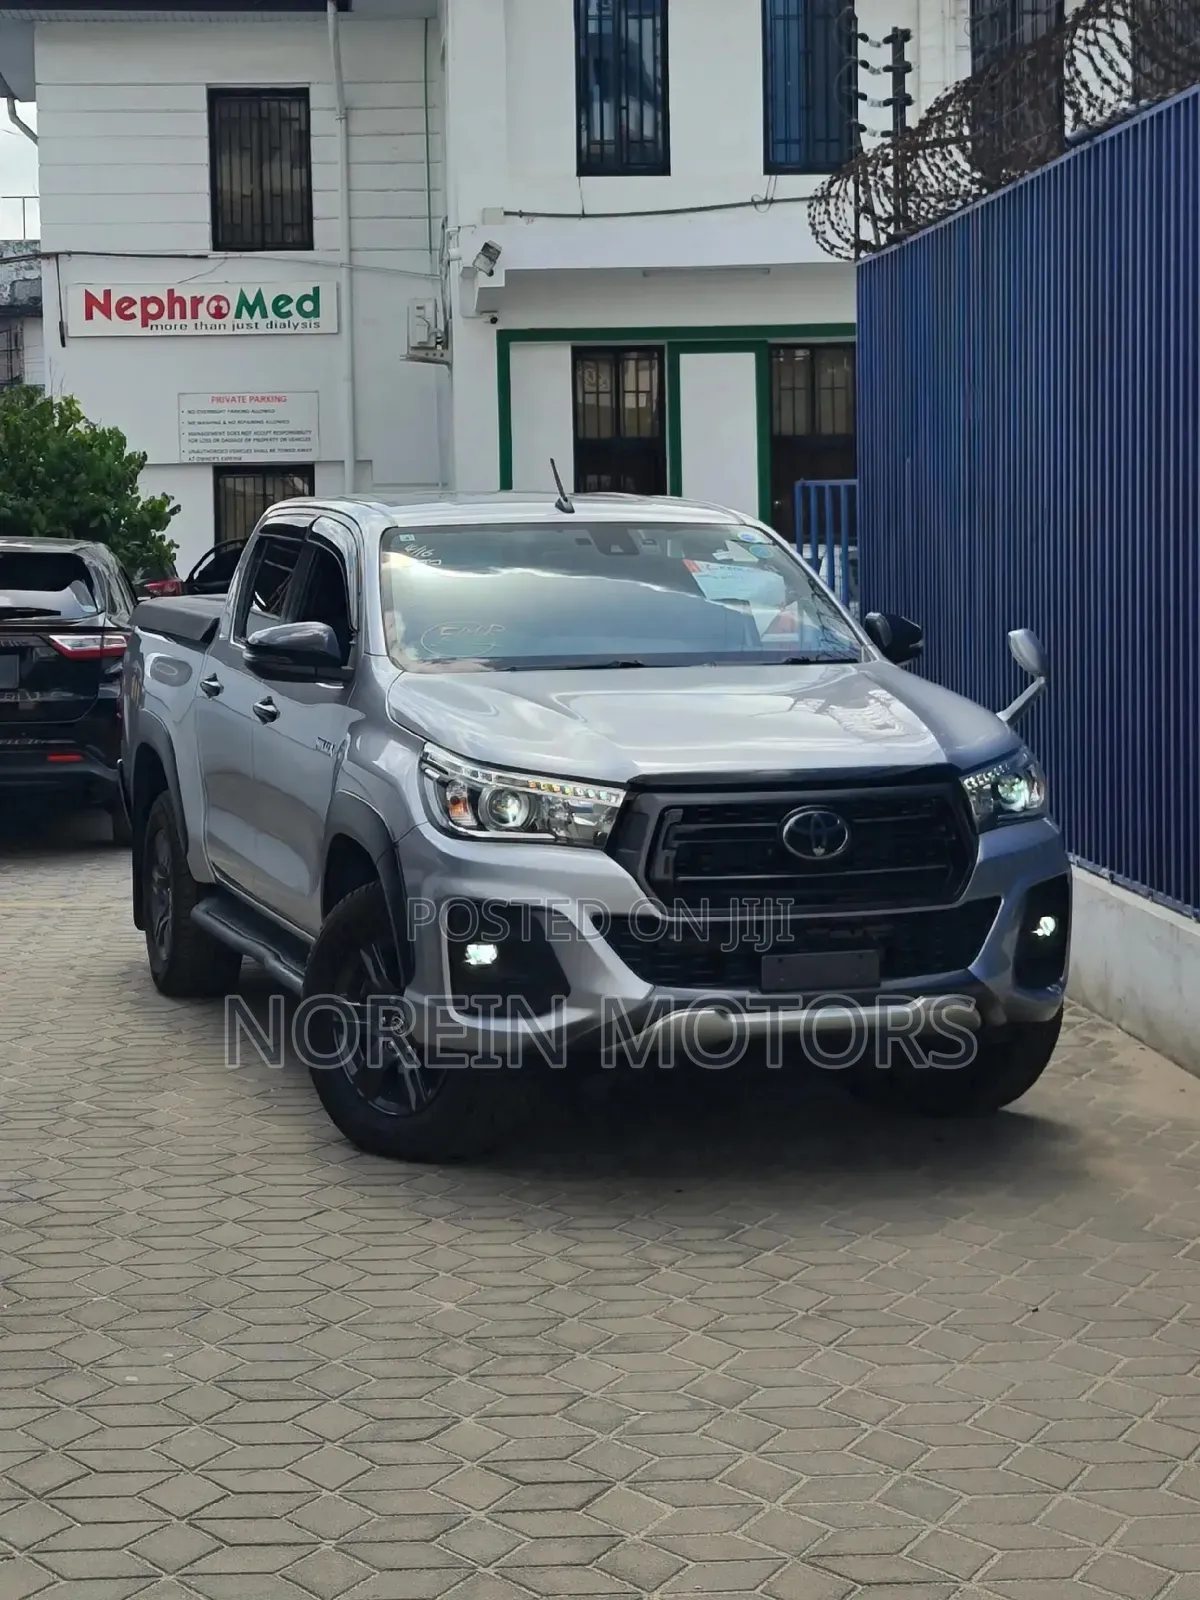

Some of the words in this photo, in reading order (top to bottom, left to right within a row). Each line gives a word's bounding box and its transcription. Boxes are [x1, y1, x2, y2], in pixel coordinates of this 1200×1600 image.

[85, 286, 320, 328] NephroMed
[150, 321, 188, 331] more
[194, 319, 227, 331] than
[230, 320, 259, 332] just
[265, 318, 321, 331] dialysis
[210, 396, 247, 404] PRIVATE
[249, 395, 287, 403] PARKING
